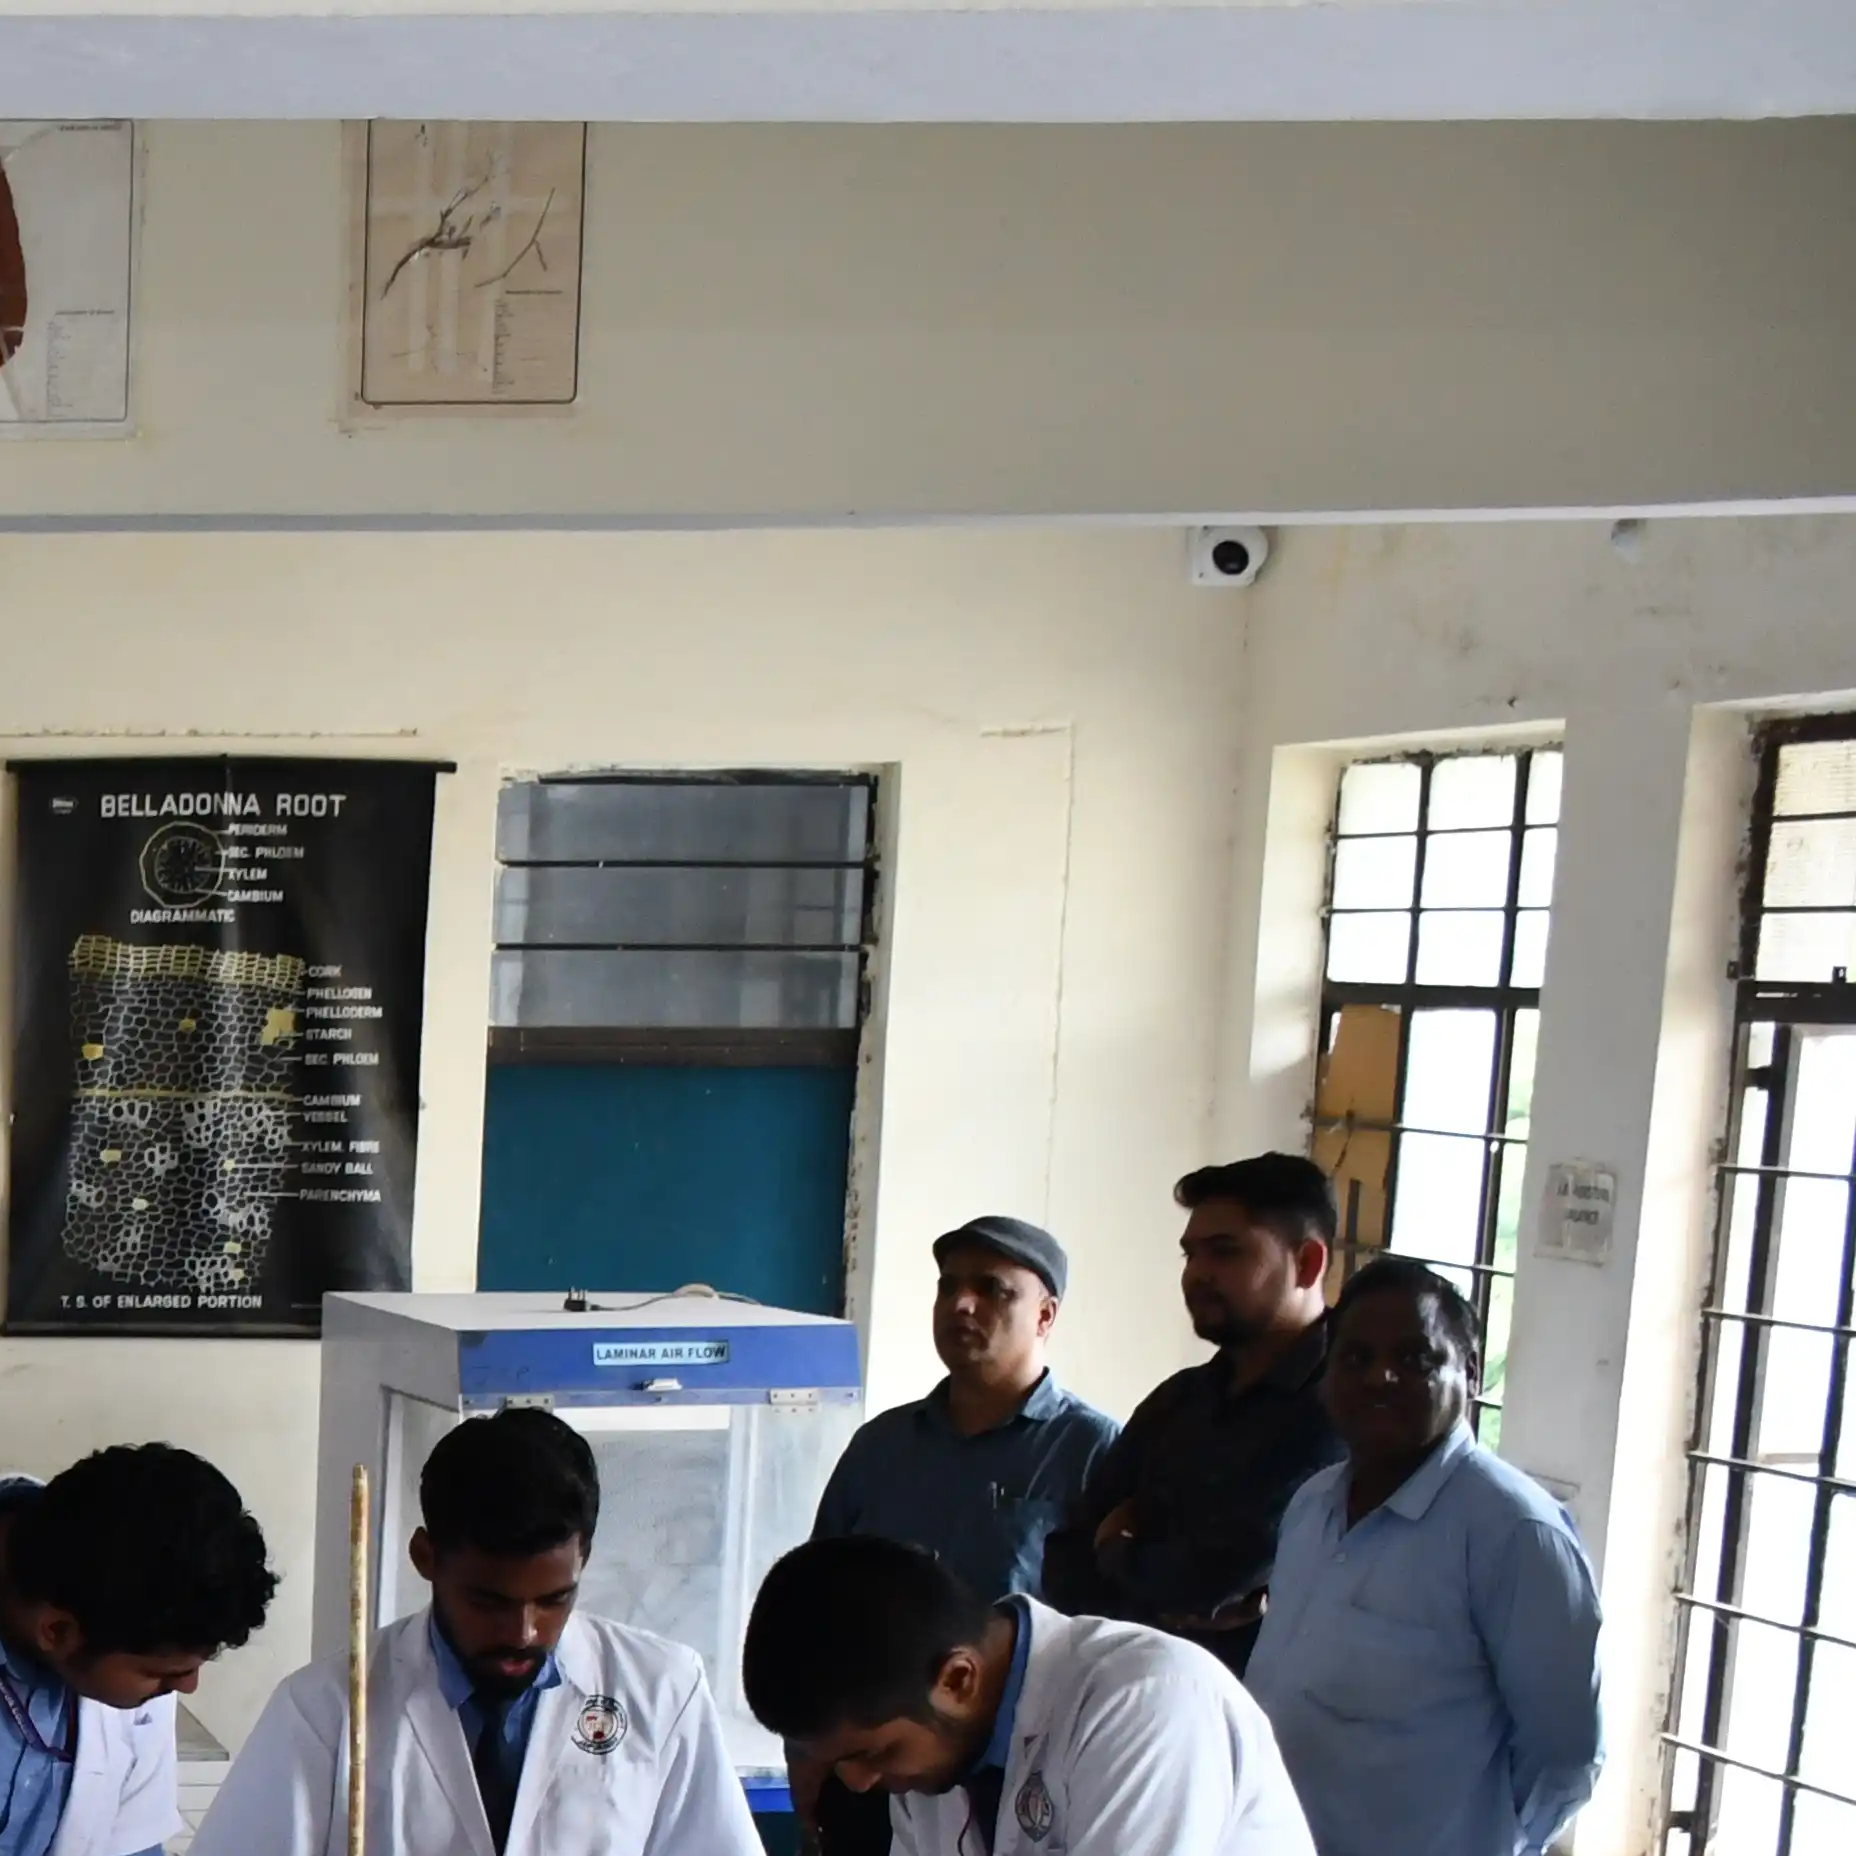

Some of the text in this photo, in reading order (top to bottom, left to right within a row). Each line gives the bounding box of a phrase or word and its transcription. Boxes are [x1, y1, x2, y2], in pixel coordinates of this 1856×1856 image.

[100, 793, 347, 818] BELLADONNA ROOT
[228, 824, 288, 837] PERIDERM
[255, 846, 305, 859] PHLOEM
[228, 868, 268, 880] XYLEM
[227, 890, 284, 903] CAMBIUM
[130, 909, 236, 925] DIAGRAMMATIC
[308, 965, 342, 977] CORK
[307, 987, 373, 1000] PHELLOGEN
[306, 1006, 383, 1019] PHELLODERM
[306, 1029, 352, 1041] STARCH
[333, 1053, 379, 1066] PHLOEM
[300, 1189, 381, 1203] PARENCHYMA
[92, 1296, 112, 1308] OF
[117, 1296, 192, 1309] ENLARGED
[197, 1296, 263, 1309] PORTION
[596, 1344, 726, 1361] LAMINAR AIR FLOW
